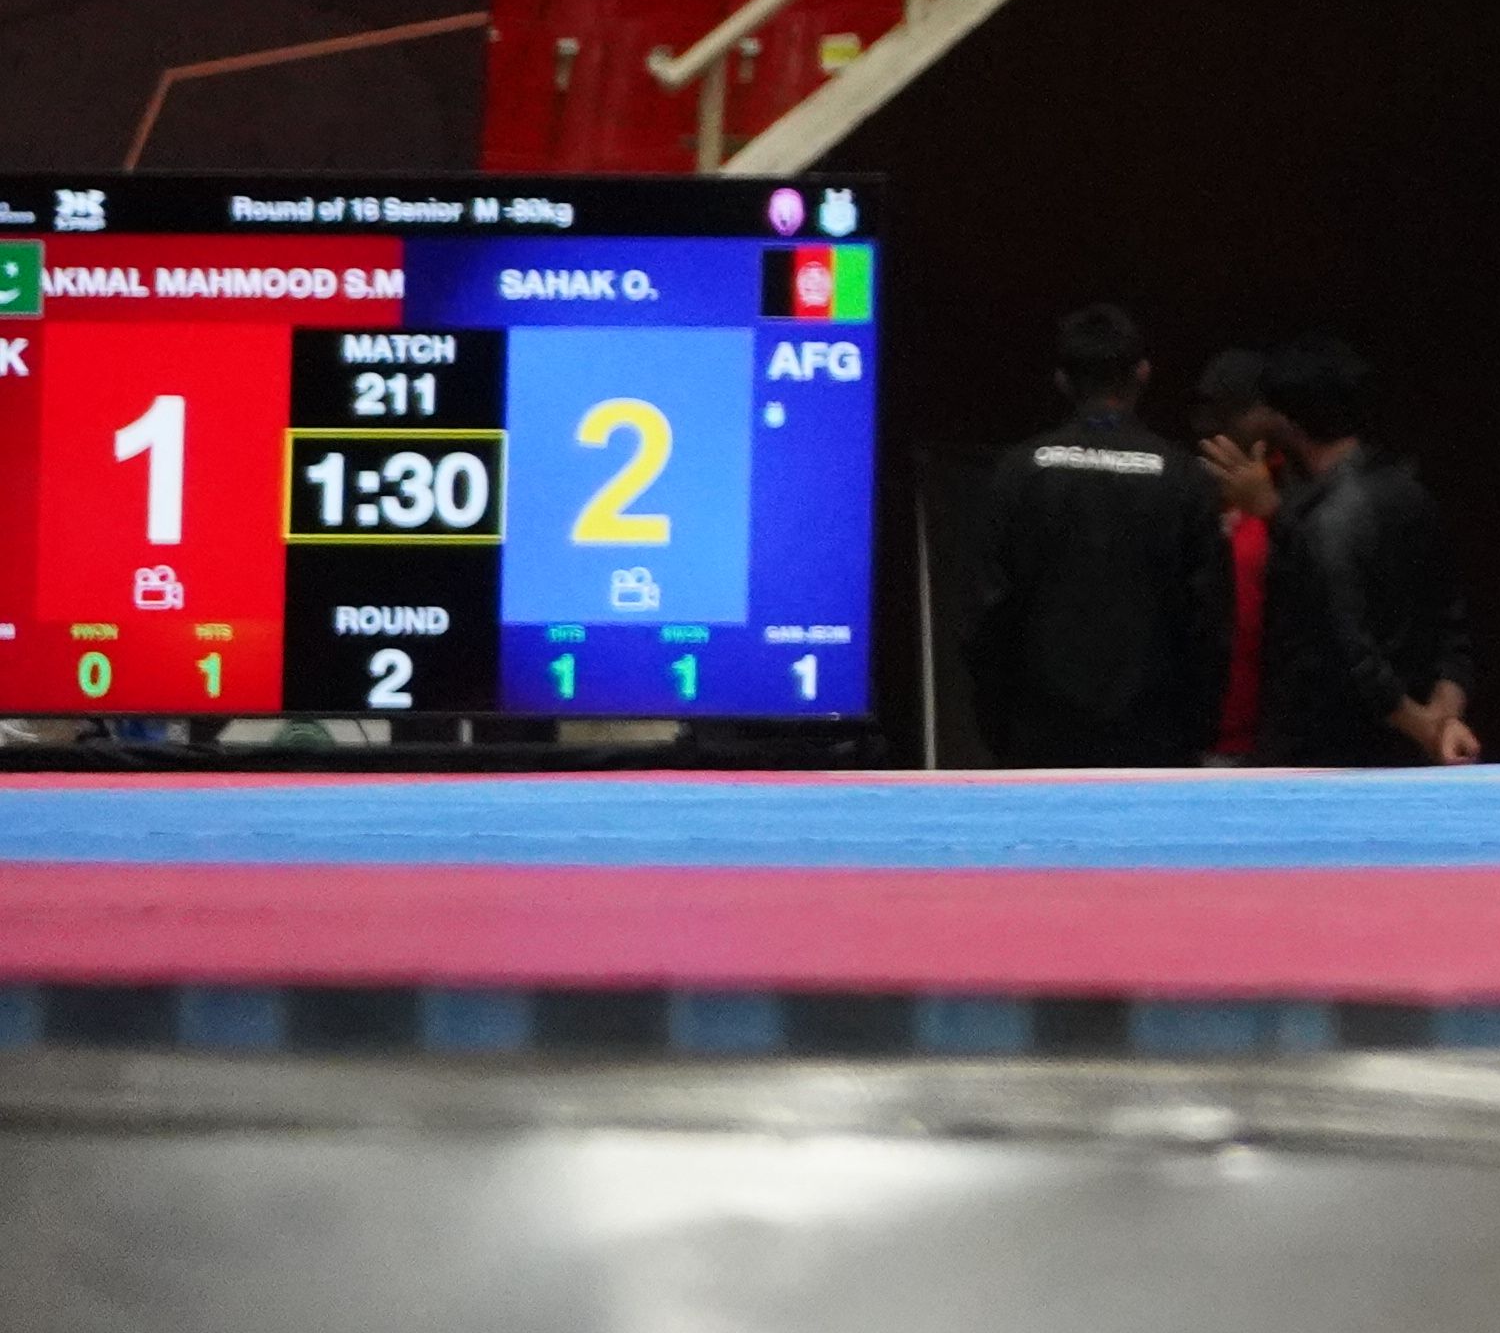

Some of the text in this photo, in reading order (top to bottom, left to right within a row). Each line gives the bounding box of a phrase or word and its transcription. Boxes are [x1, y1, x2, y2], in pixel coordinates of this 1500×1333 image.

[232, 196, 314, 222] Round
[318, 196, 345, 222] of
[384, 196, 464, 223] Senior
[473, 197, 499, 223] M
[155, 267, 338, 300] MAHMOOD
[500, 269, 659, 300] SAHAK O.
[343, 335, 456, 365] MATCH
[768, 342, 863, 381] AFG
[354, 373, 435, 415] 211
[114, 394, 186, 545] 1
[306, 452, 490, 528] 1:30
[571, 398, 674, 545] 2
[336, 605, 449, 636] ROUND
[78, 651, 112, 698] 0
[197, 652, 221, 698] 1
[368, 648, 413, 708] 2
[549, 653, 576, 701] 1
[671, 653, 698, 701] 1
[792, 653, 818, 701] 1
